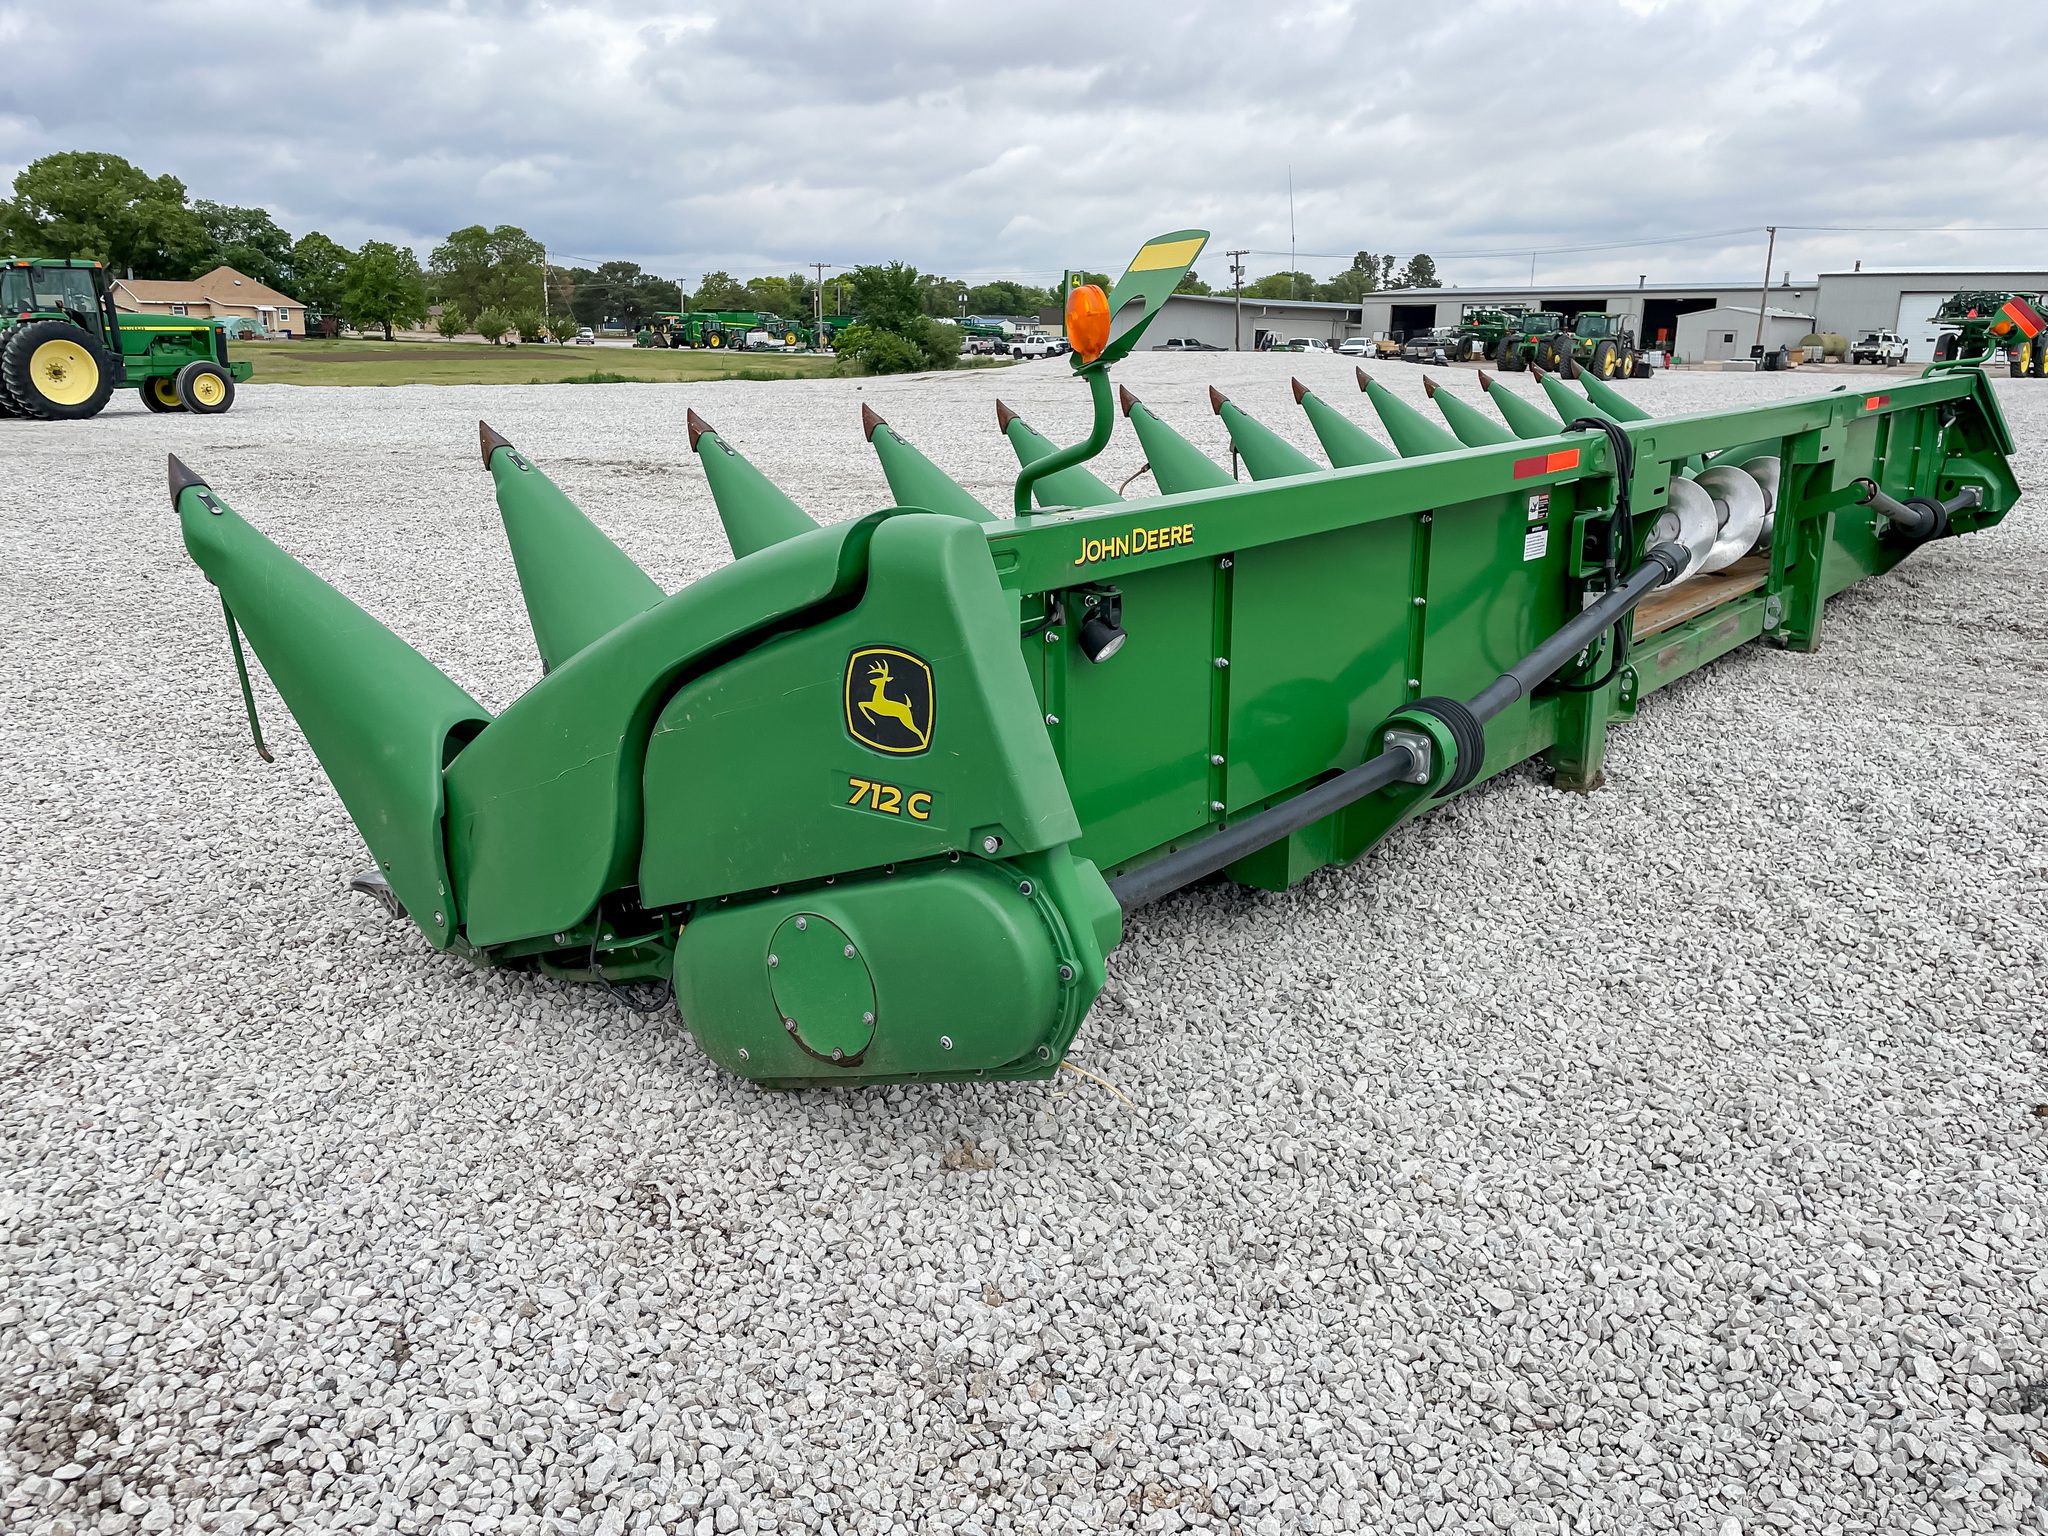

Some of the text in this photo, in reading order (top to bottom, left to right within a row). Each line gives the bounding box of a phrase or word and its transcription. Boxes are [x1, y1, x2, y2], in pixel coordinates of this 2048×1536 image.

[1074, 523, 1195, 567] JOHN DEERE
[847, 776, 933, 821] 712 C
